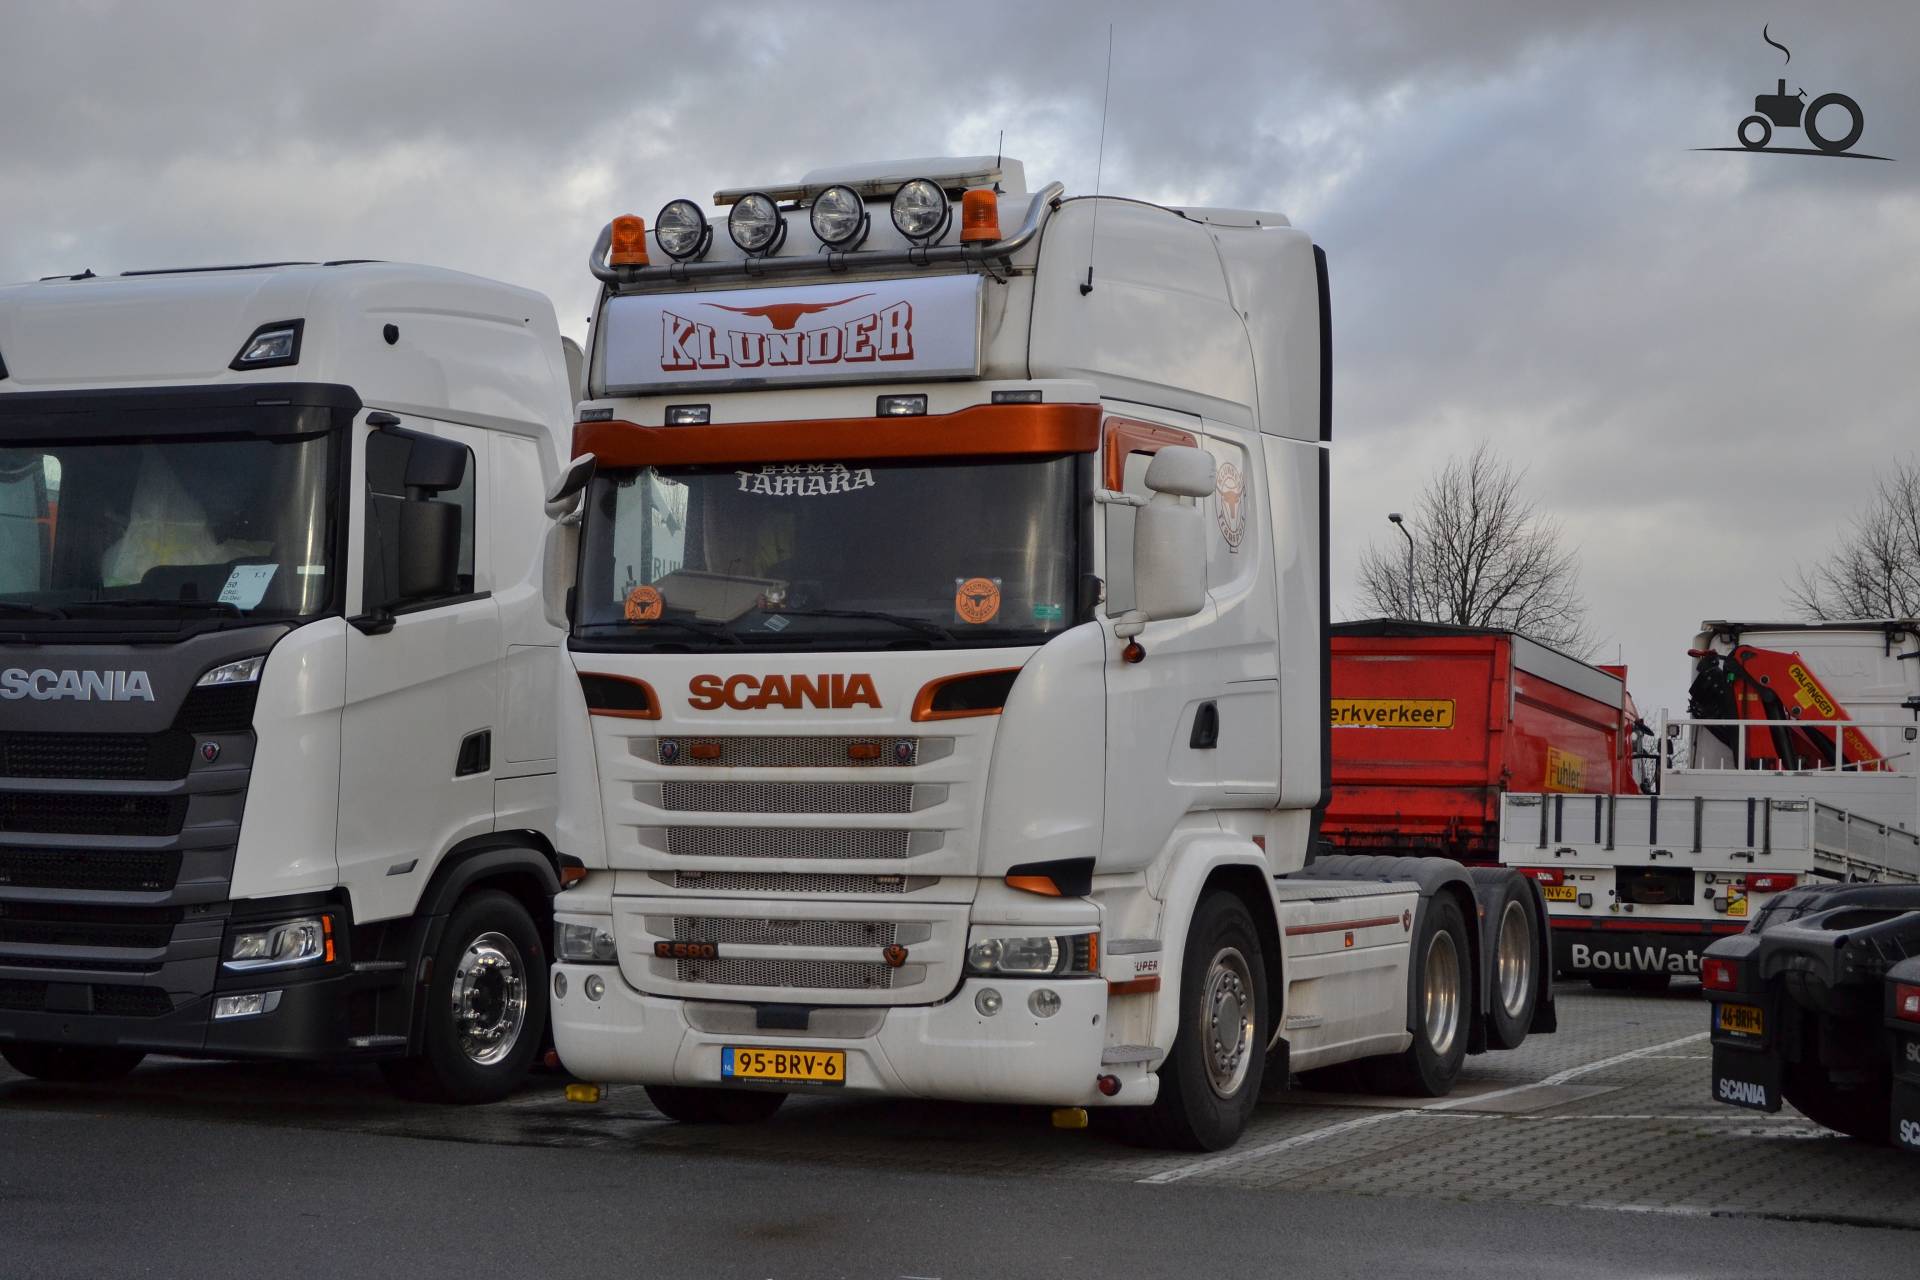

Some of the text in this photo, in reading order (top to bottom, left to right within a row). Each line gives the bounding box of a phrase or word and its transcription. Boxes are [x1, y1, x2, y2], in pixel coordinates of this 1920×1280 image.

[660, 300, 914, 372] KLUNDER
[735, 468, 876, 496] TAMARA
[0, 668, 155, 702] SCANIA
[687, 673, 883, 711] SCANIA
[1791, 667, 1833, 715] PALFINGER
[739, 1053, 836, 1076] 95-BRV-6
[1720, 1078, 1766, 1105] SCANIA
[1899, 1119, 1920, 1146] SC
